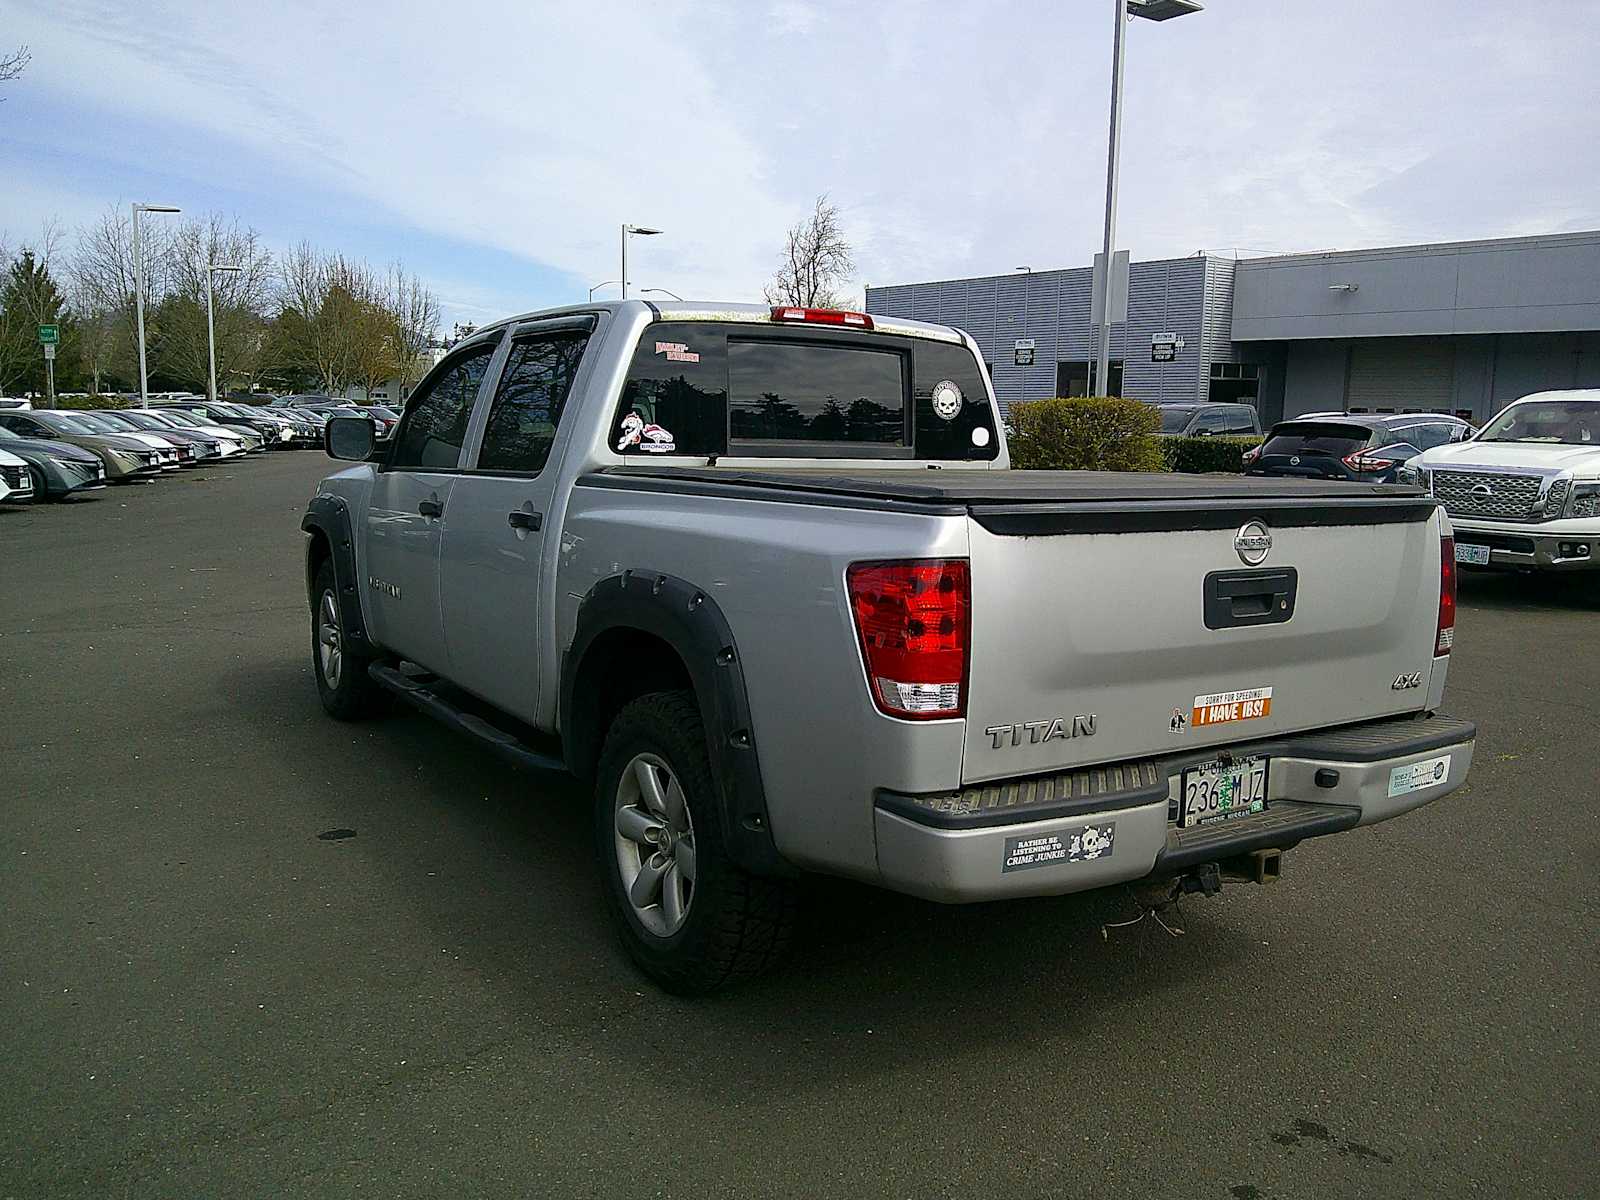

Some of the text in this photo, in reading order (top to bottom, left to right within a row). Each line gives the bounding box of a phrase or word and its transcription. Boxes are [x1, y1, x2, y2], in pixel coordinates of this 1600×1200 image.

[1237, 537, 1271, 547] NISSAN
[1205, 696, 1223, 704] SORRY
[1225, 694, 1235, 702] FOR
[1200, 700, 1265, 724] I HAVE IBS!
[985, 714, 1097, 749] TITAN
[1187, 770, 1264, 815] 236 MJZ
[1227, 810, 1251, 819] NISSAN
[1018, 836, 1059, 849] RATHER BE
[1012, 843, 1051, 856] LISTENING
[1006, 849, 1066, 866] CRIME JUNKIE
